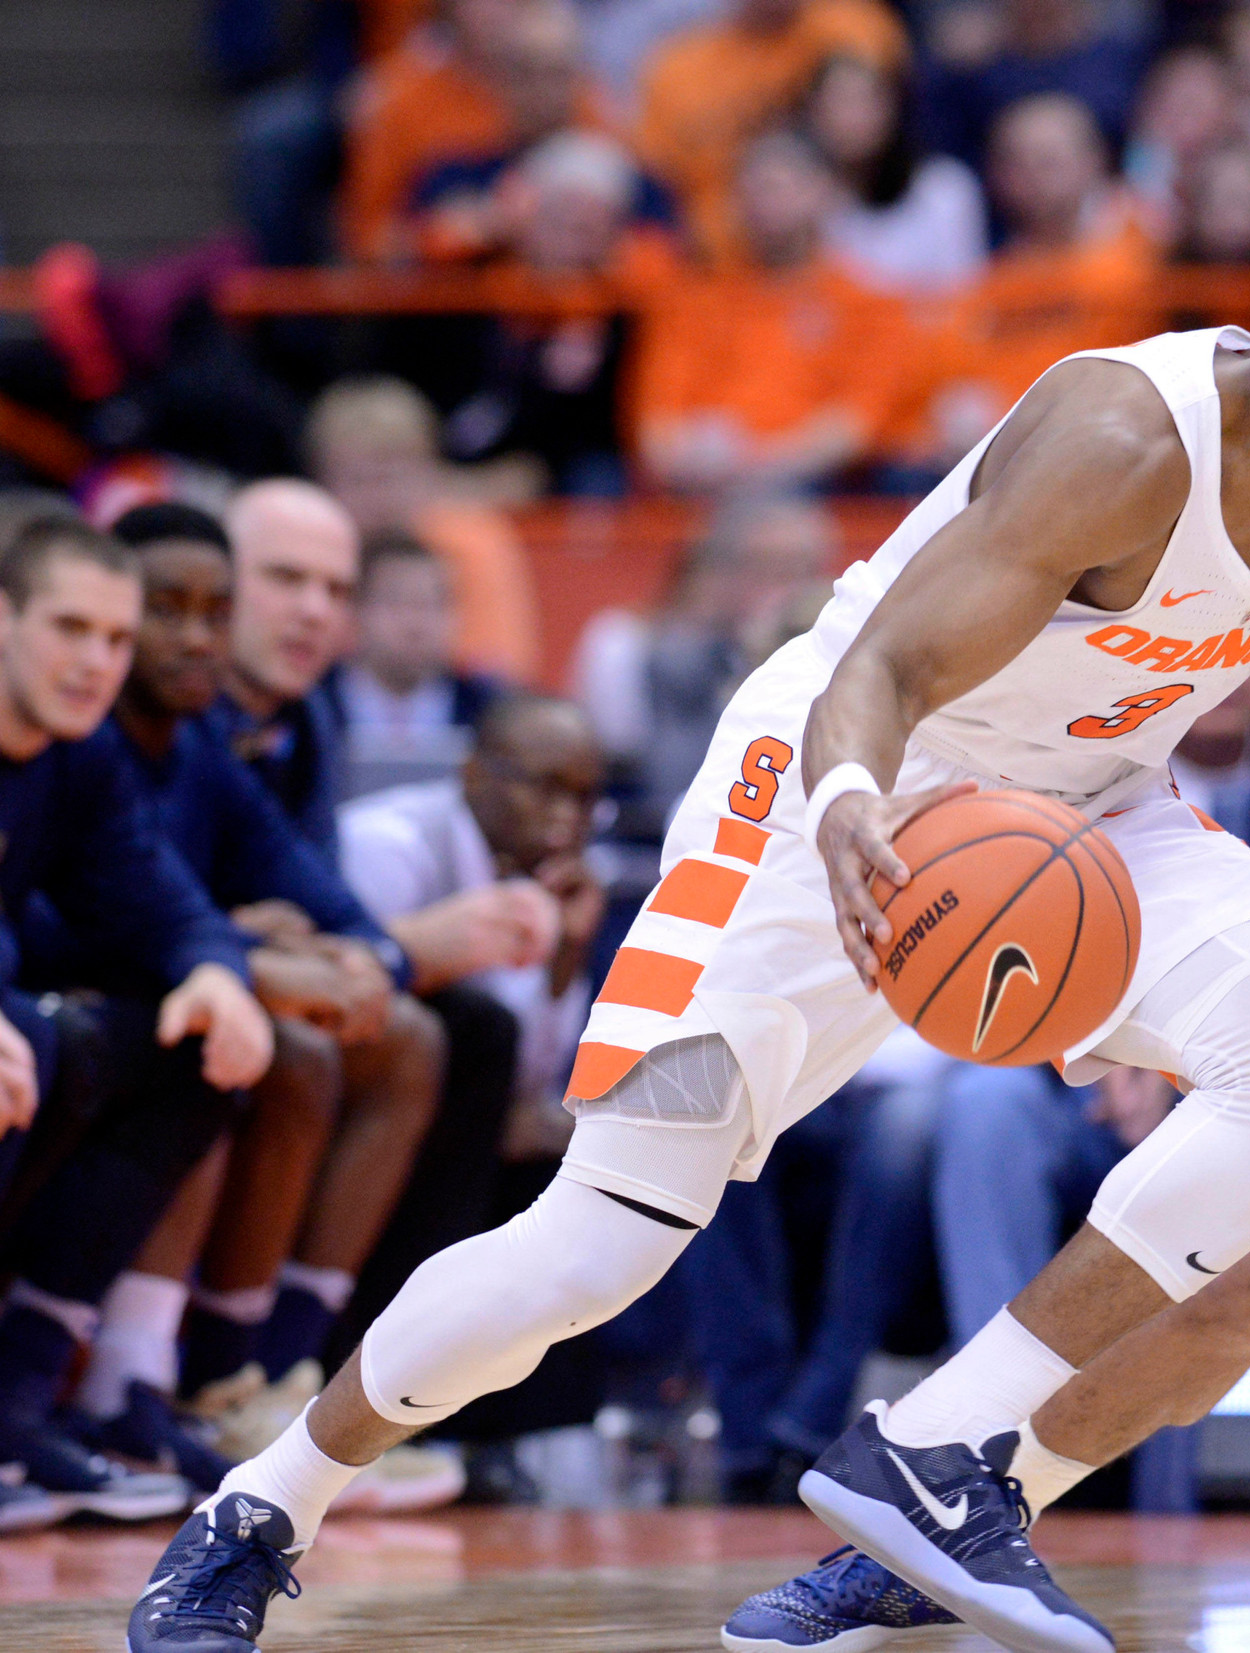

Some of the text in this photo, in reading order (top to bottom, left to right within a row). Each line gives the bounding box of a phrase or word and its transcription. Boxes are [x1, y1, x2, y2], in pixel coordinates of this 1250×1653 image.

[1067, 684, 1194, 739] 3
[728, 735, 794, 822] S
[885, 889, 959, 982] SYRACUSE
